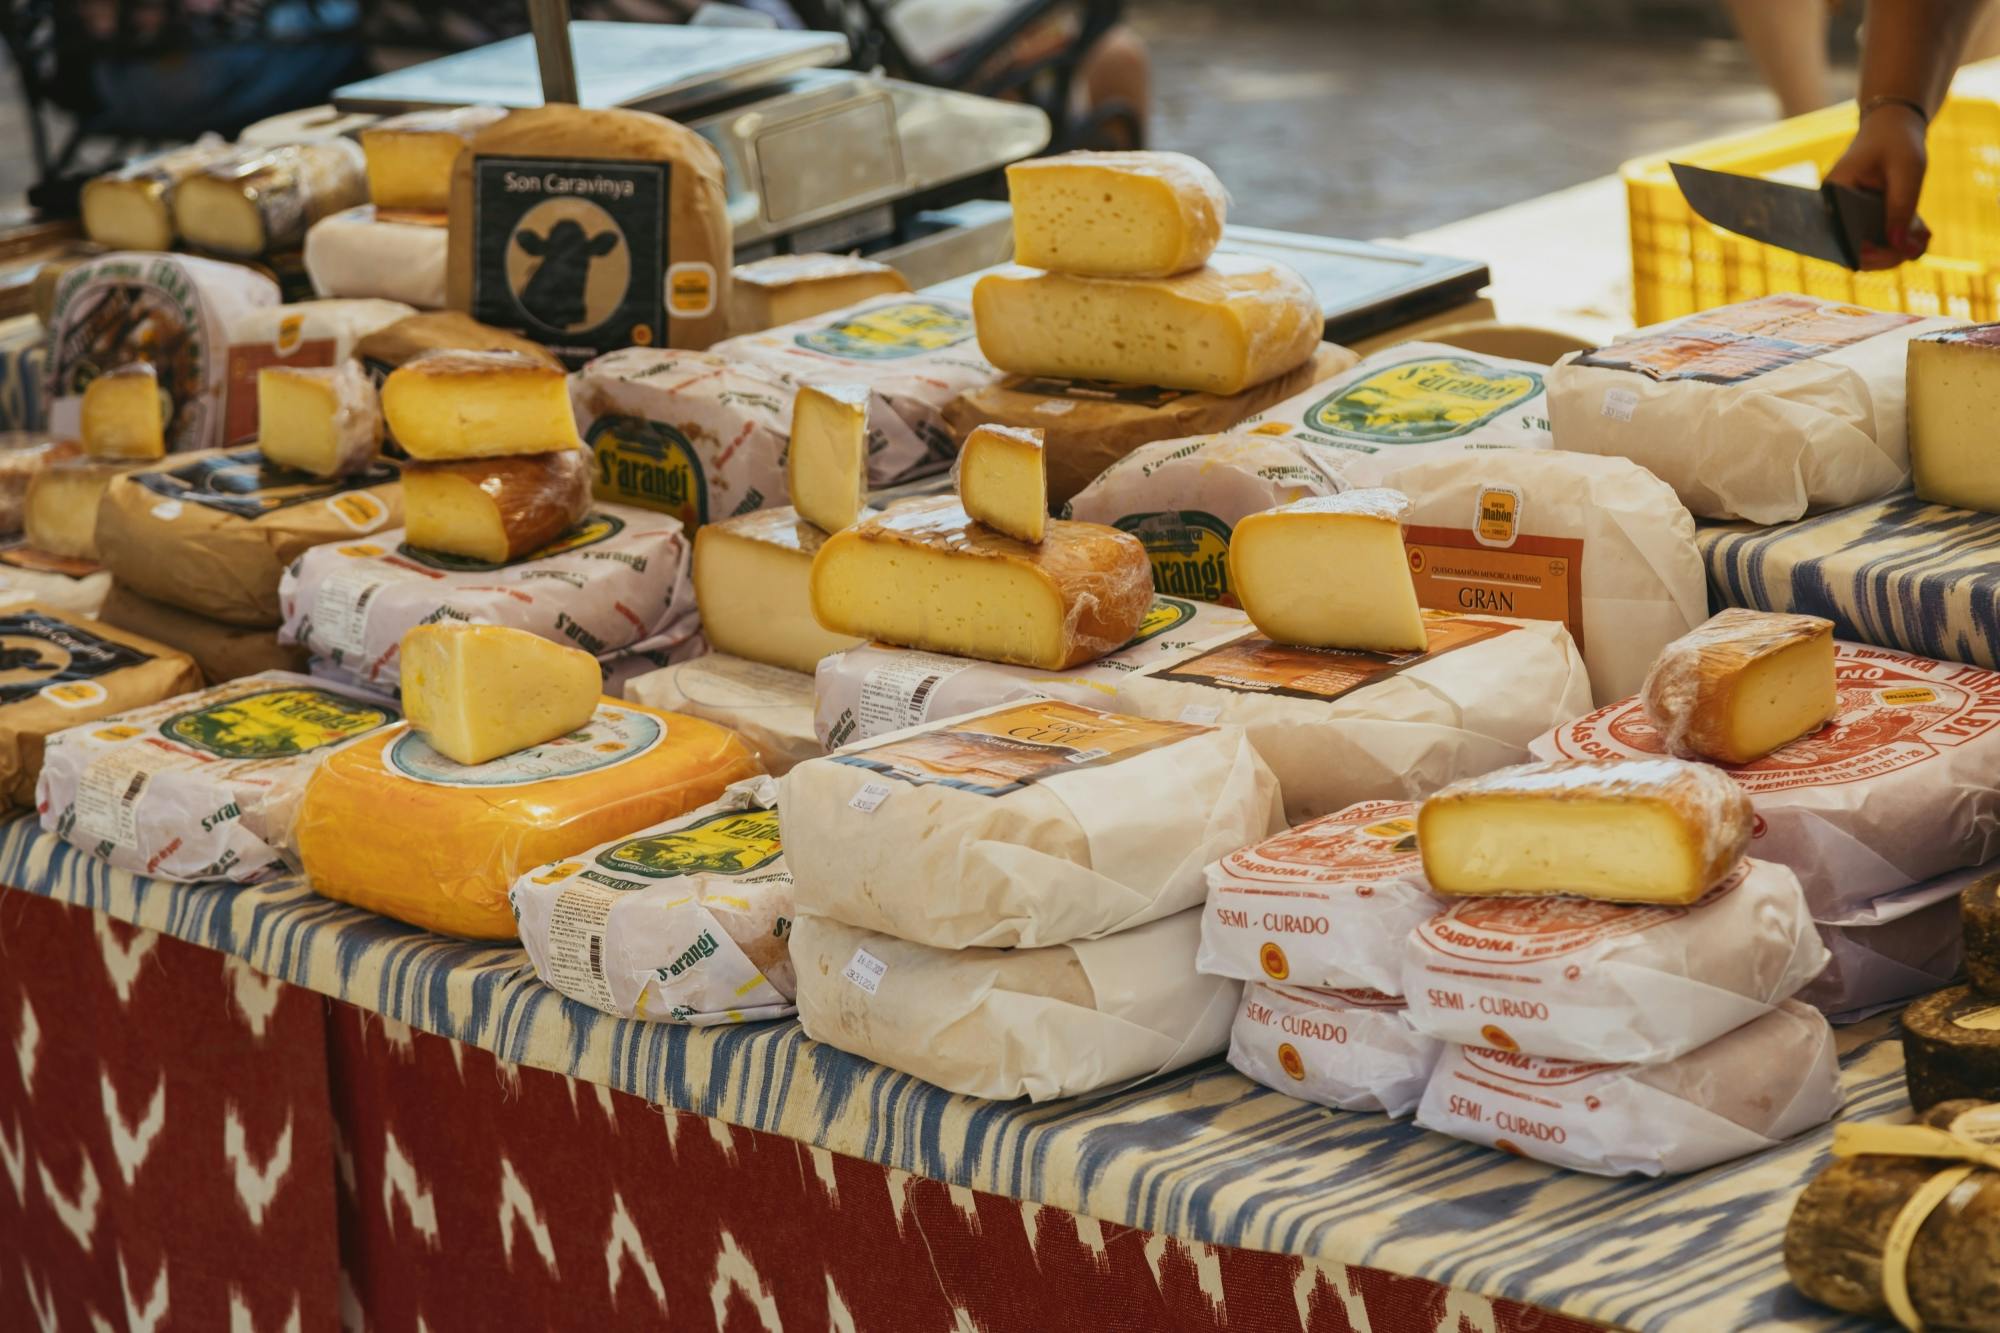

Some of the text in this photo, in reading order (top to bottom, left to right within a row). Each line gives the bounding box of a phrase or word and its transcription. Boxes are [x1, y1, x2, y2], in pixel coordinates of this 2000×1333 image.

[504, 172, 635, 199] Son Caravinya
[1458, 587, 1514, 613] GRAN
[1217, 908, 1248, 929] SEMI
[1263, 912, 1329, 935] CURADO
[1434, 924, 1515, 952] CARDONA
[1427, 988, 1464, 1010] SEMI
[1479, 995, 1549, 1021] CURADO
[1247, 1001, 1273, 1026] SEMI
[1281, 1015, 1348, 1044] CURADO
[1449, 1095, 1482, 1122] SEMI
[1496, 1111, 1566, 1144] CURADO
